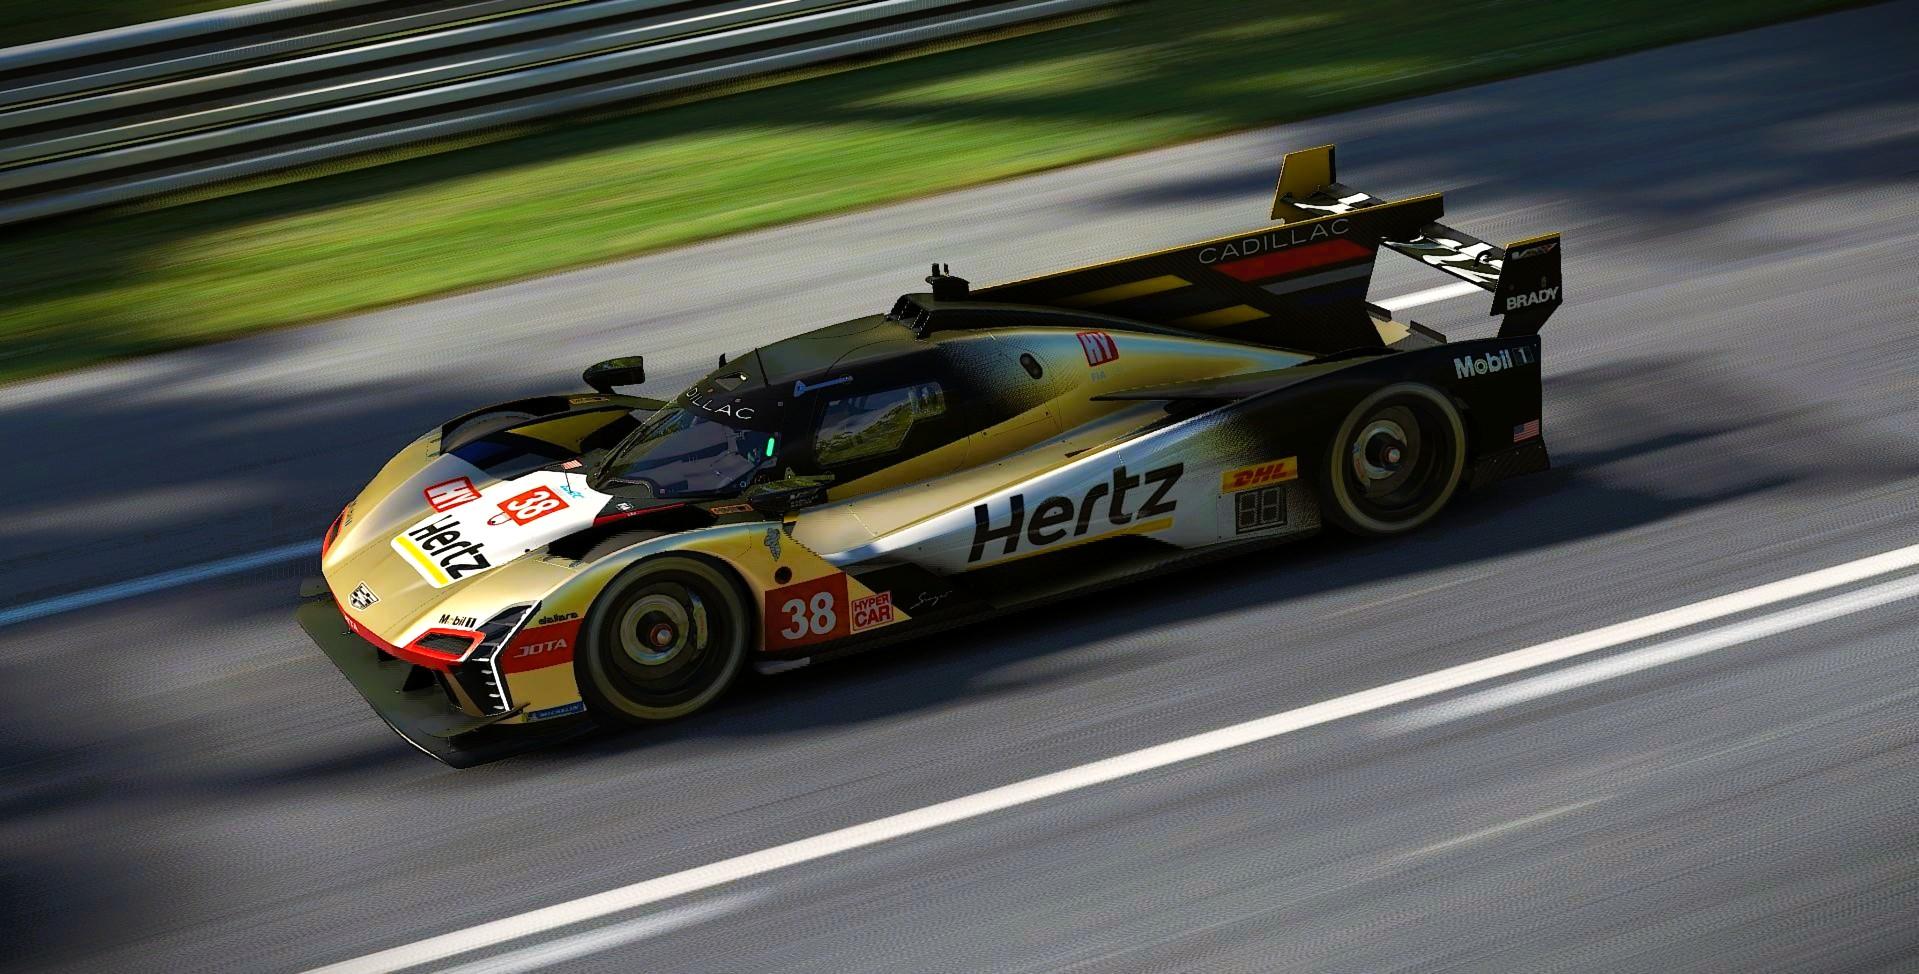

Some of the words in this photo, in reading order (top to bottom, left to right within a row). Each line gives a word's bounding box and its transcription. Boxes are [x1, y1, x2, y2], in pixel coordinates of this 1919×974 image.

[1198, 218, 1350, 265] CADILLAC
[1506, 286, 1559, 311] BRADY
[1079, 333, 1113, 364] HY
[1453, 348, 1513, 379] Mobil
[686, 386, 755, 420] DILLAC
[1232, 462, 1288, 488] DHL
[427, 479, 477, 510] HY
[507, 490, 560, 520] 38
[967, 462, 1184, 563] Hertz
[408, 514, 491, 580] Hertz
[781, 591, 837, 640] 38
[854, 593, 890, 612] HYPER
[854, 605, 891, 628] CAR
[513, 638, 567, 658] JOTA
